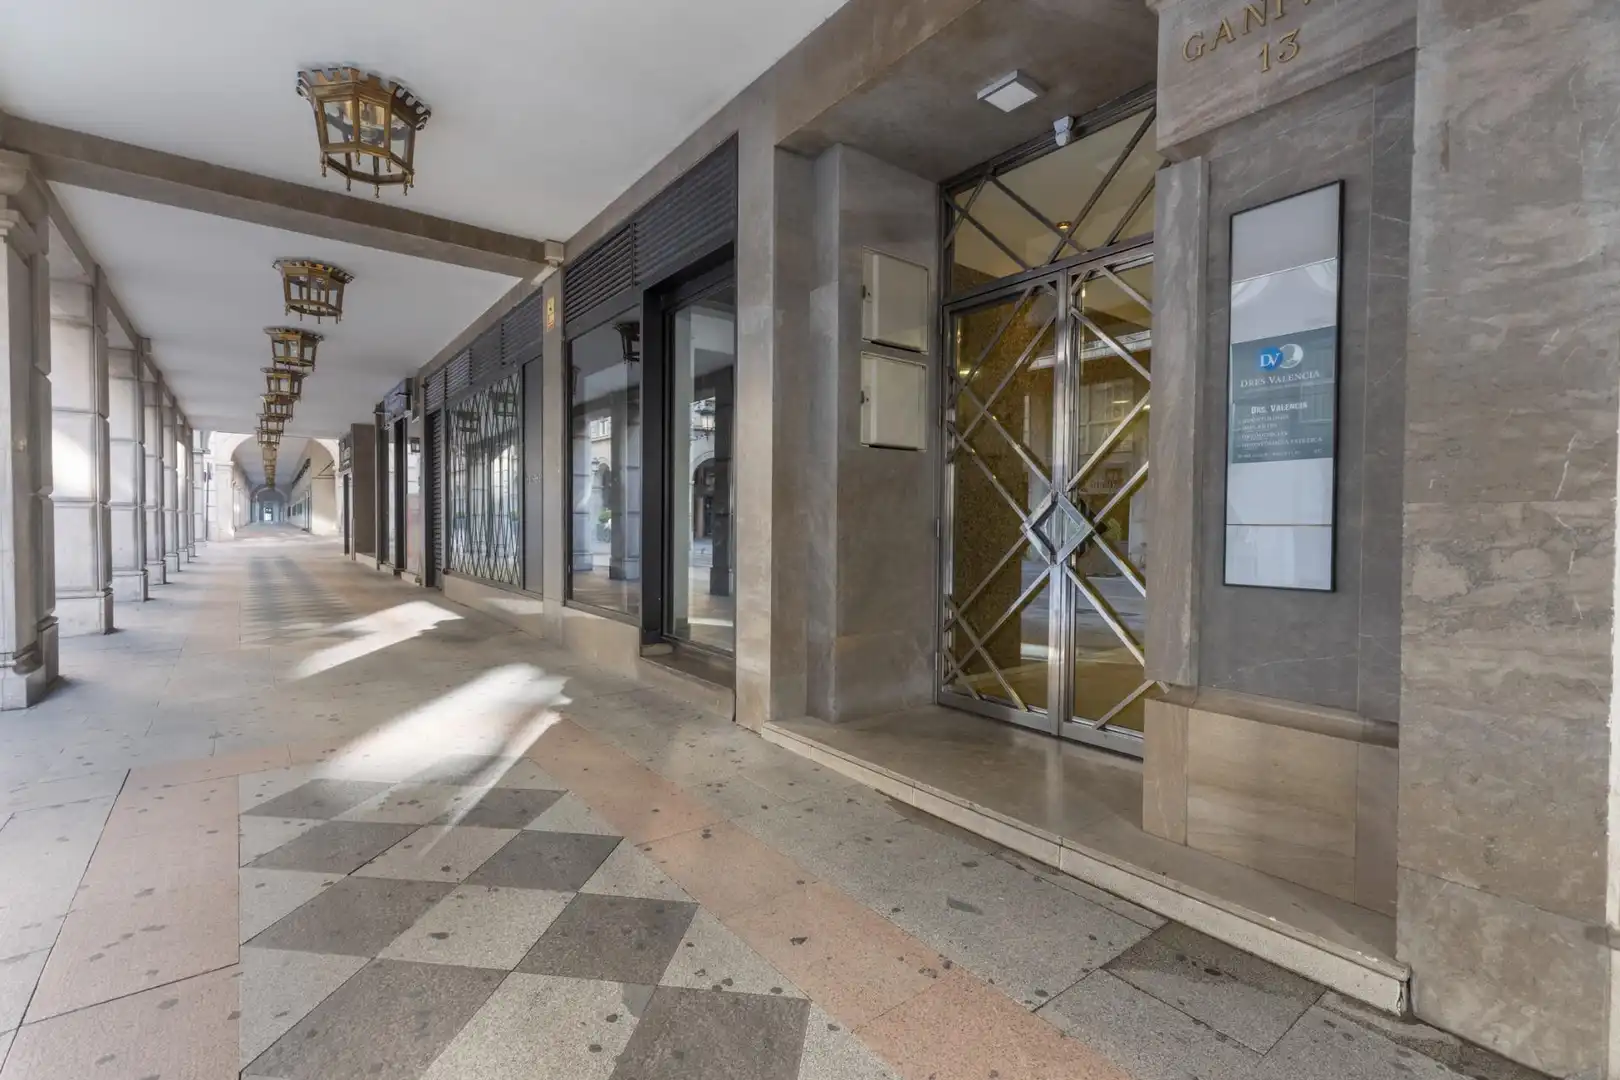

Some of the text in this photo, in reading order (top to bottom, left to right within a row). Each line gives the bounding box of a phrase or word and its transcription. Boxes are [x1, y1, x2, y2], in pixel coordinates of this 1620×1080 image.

[1183, 0, 1311, 62] GANI
[1258, 28, 1300, 73] 13
[1260, 352, 1281, 368] DV
[1268, 370, 1320, 384] VALENCIA
